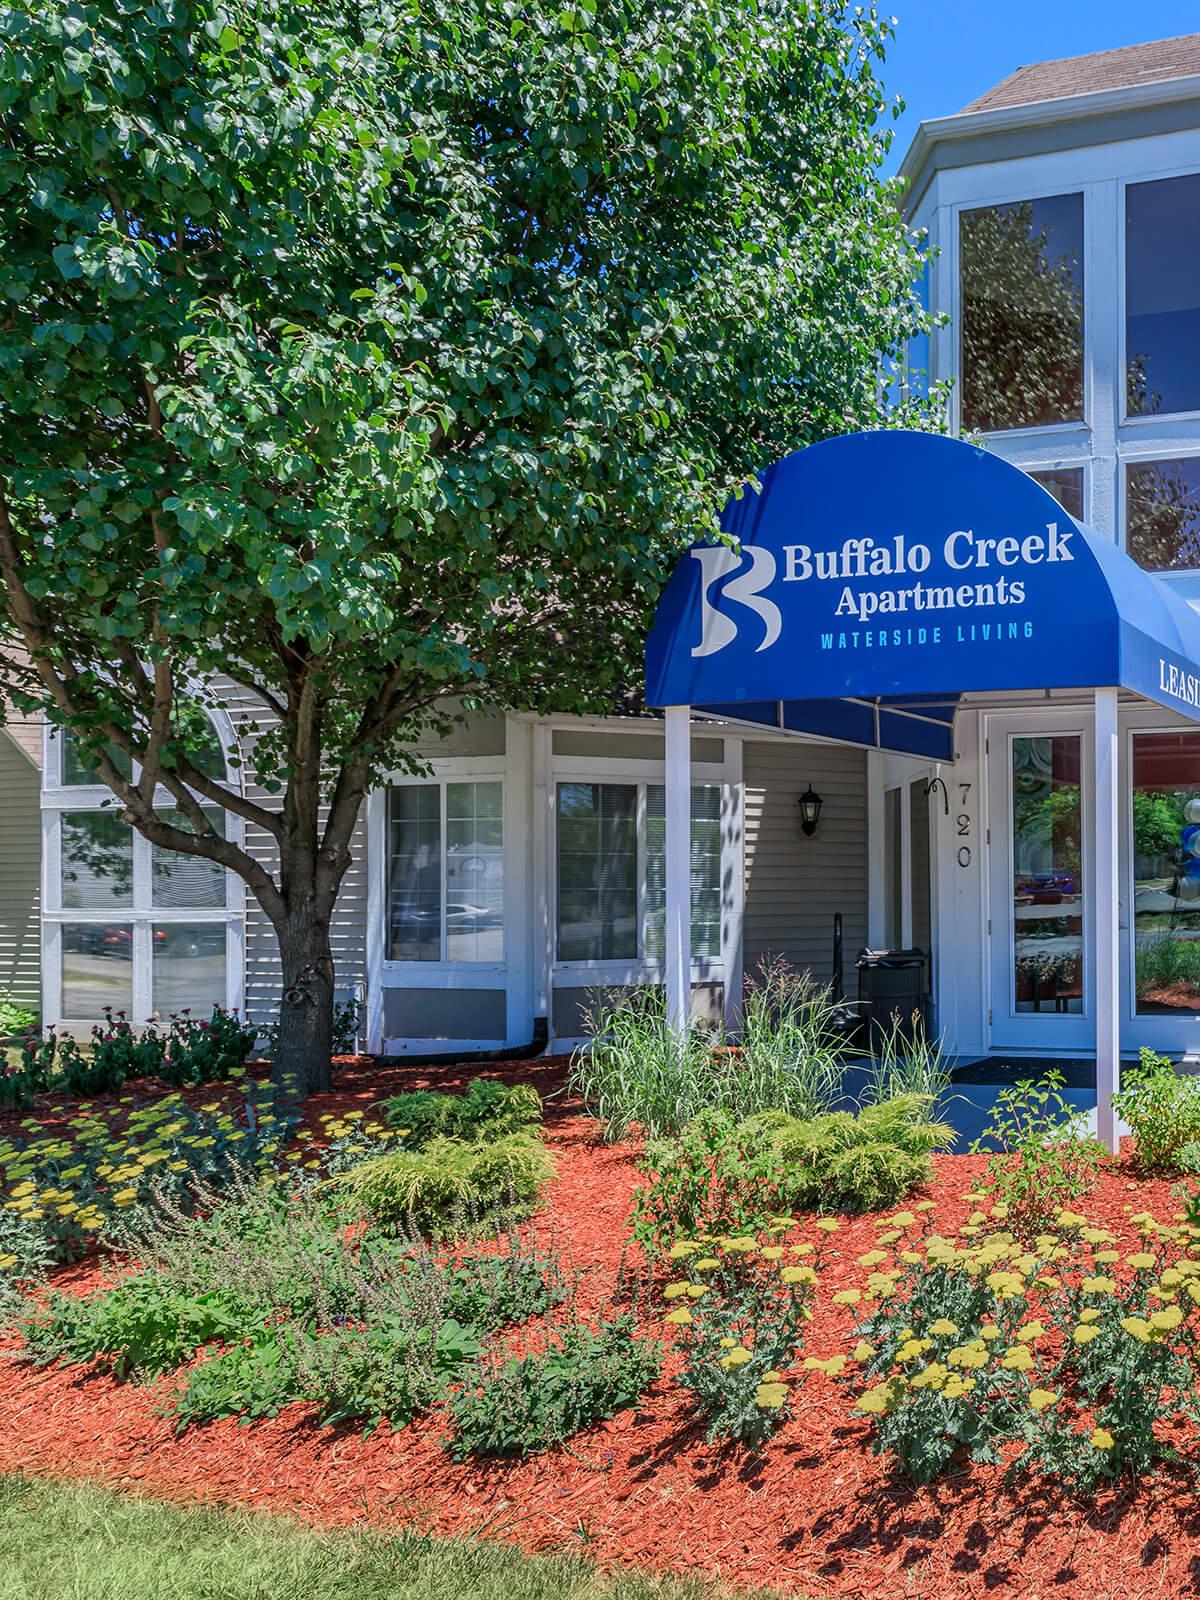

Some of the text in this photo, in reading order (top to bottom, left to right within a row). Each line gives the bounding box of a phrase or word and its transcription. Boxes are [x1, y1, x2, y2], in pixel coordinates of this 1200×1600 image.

[782, 522, 1075, 582] Buffalo Creek
[834, 575, 1026, 622] Apartments
[821, 621, 1033, 649] WATERSIDE LIVING
[957, 783, 972, 868] 720
